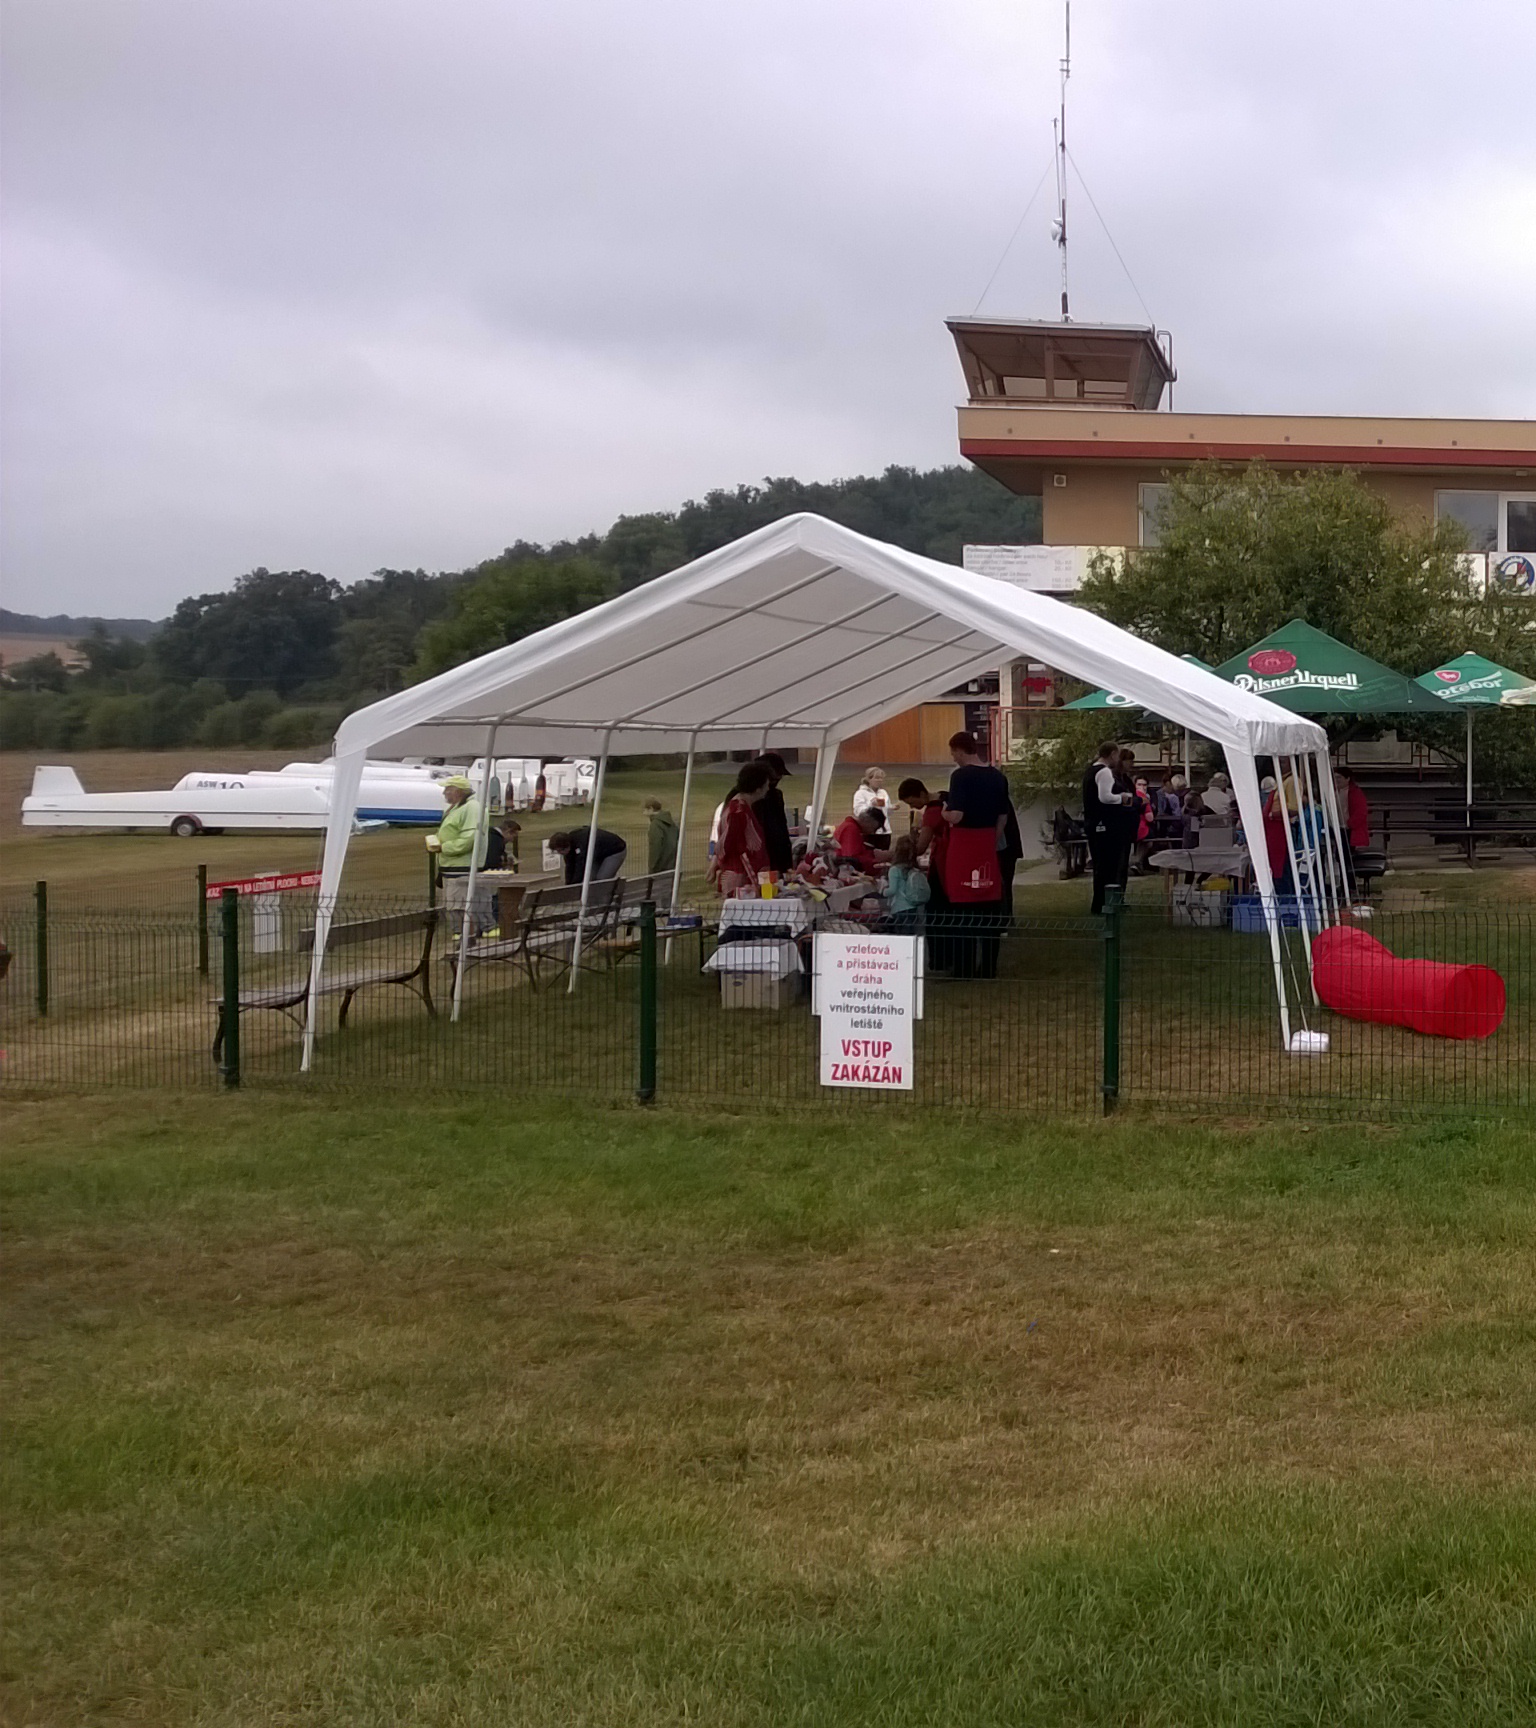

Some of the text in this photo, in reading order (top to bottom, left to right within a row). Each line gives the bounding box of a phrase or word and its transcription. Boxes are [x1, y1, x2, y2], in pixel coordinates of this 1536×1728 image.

[1234, 669, 1358, 692] Pilsner Urquell
[837, 959, 899, 971] a přistávací
[852, 974, 883, 985] dráha
[841, 989, 894, 1001] veřejného
[829, 1003, 904, 1016] vnitrostátního
[851, 1018, 883, 1029] letiště
[841, 1039, 892, 1058] VSTUP
[831, 1060, 902, 1084] ZAKÁZÁN
